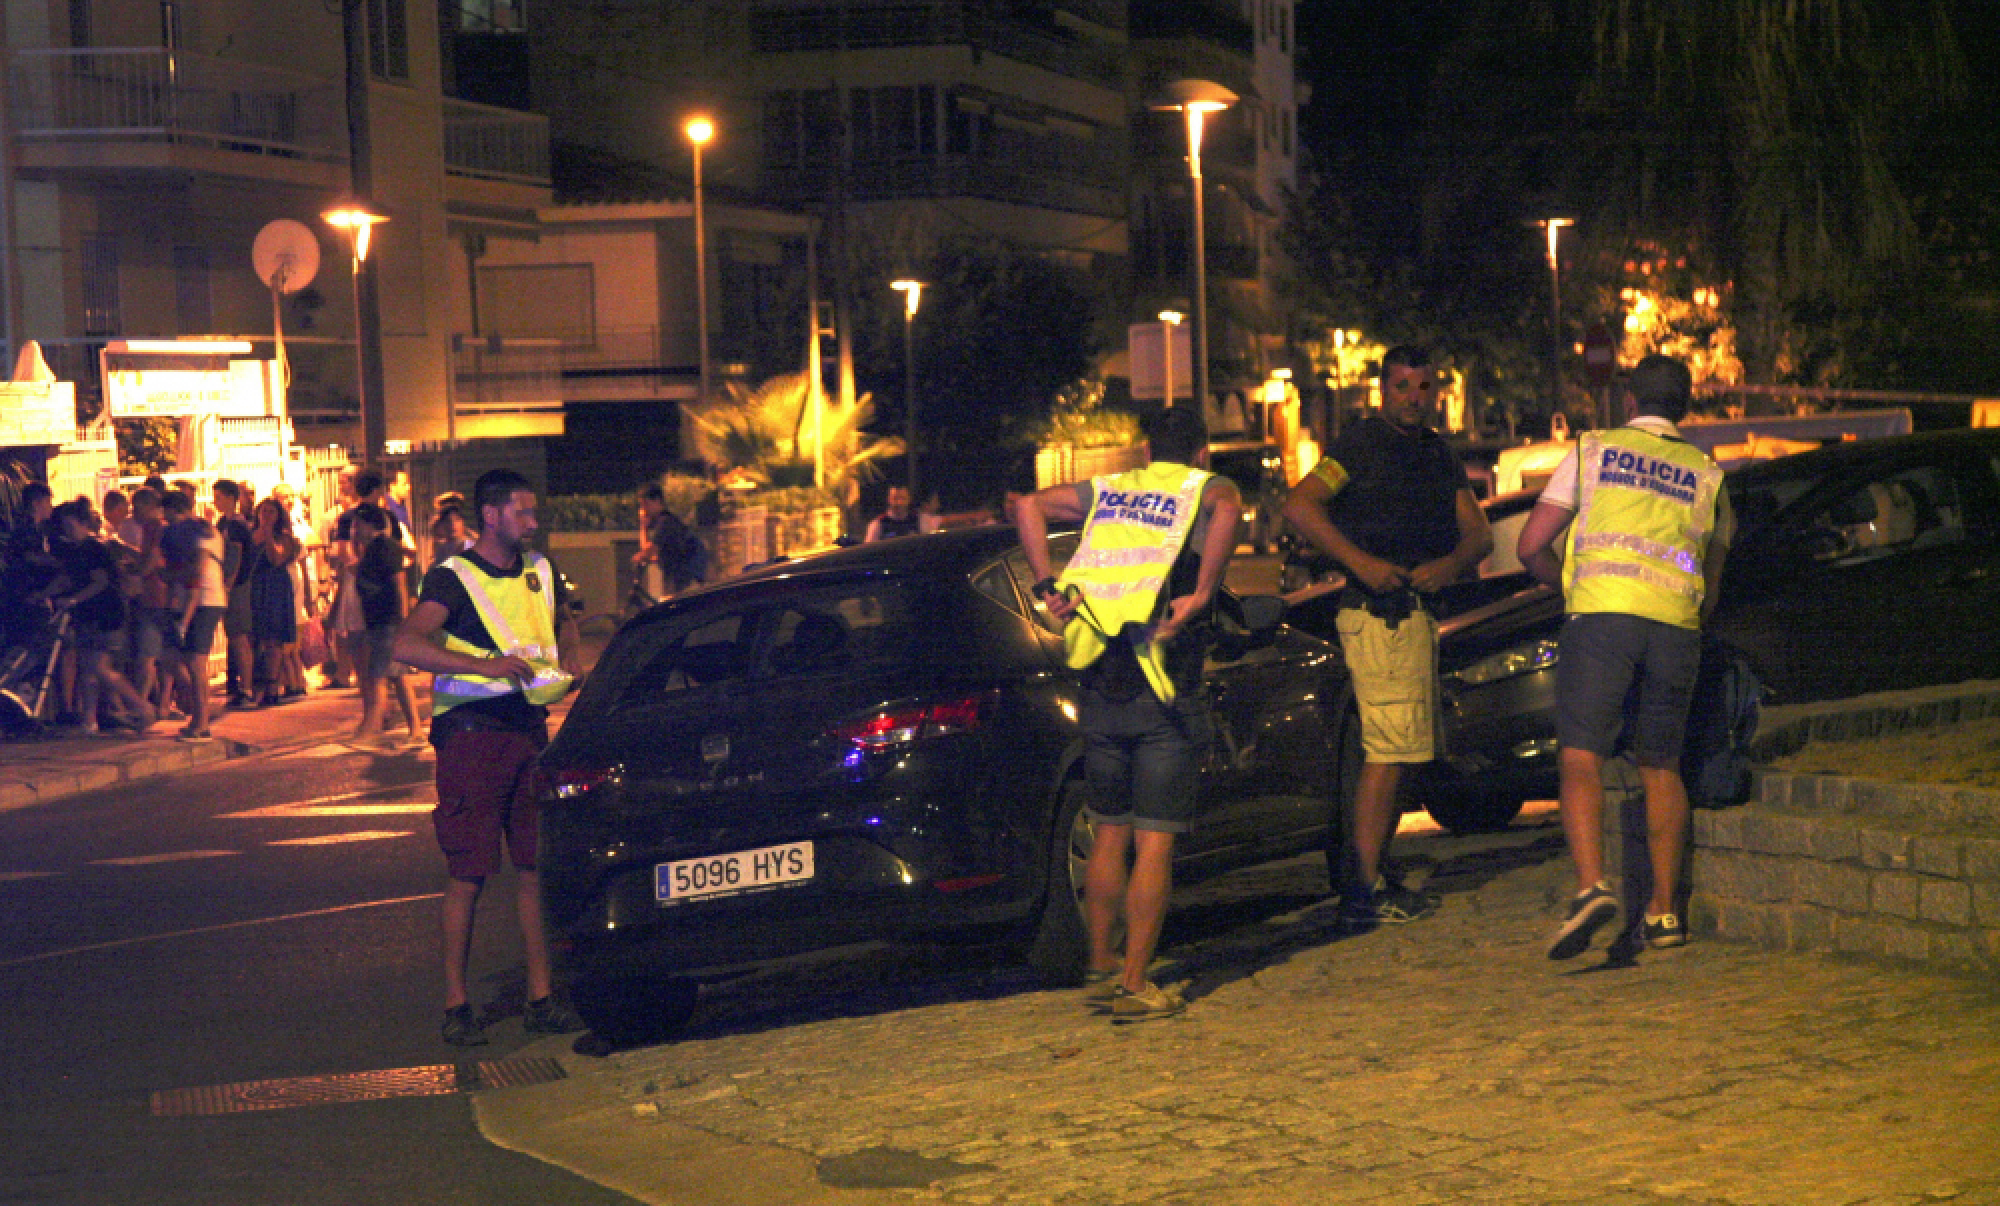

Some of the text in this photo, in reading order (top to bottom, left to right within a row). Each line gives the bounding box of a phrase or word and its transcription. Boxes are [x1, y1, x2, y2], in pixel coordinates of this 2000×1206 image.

[1602, 449, 1697, 490] POLICIA
[1099, 490, 1177, 516] POLICIA
[675, 848, 803, 892] 5096 HYS
